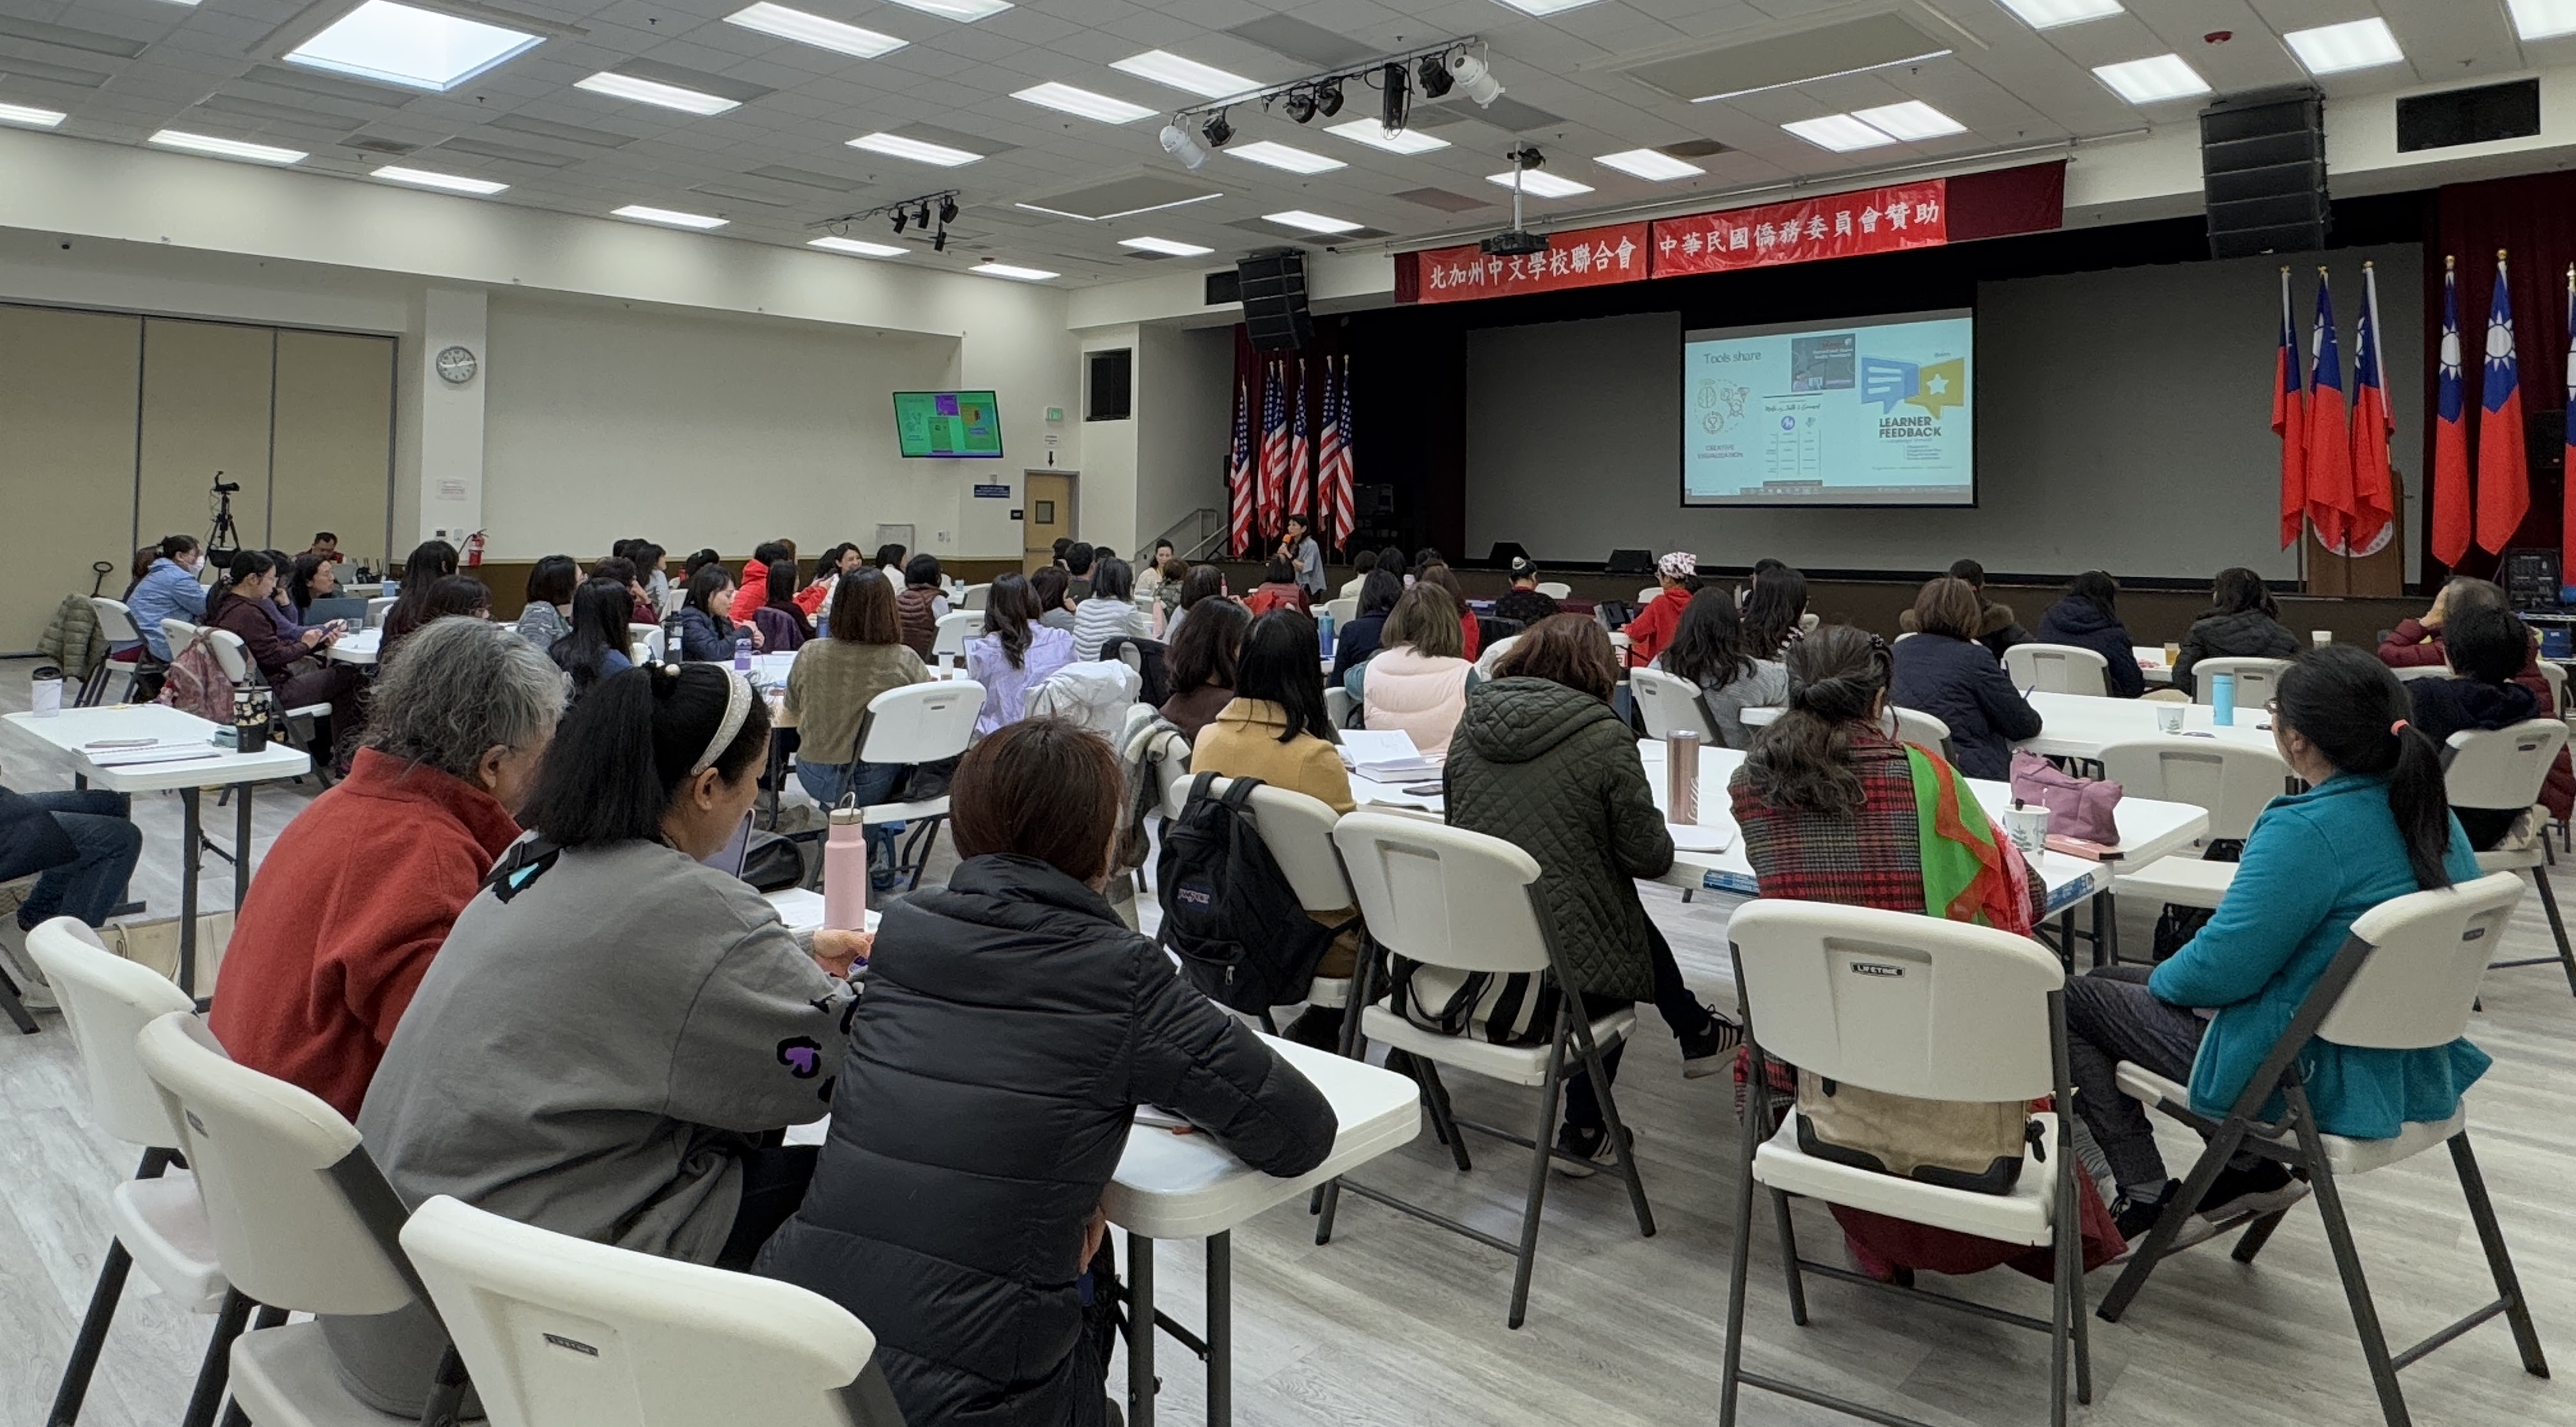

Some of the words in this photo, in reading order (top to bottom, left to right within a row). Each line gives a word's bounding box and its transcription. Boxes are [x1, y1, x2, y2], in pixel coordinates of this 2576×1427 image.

[1430, 235, 1636, 289] 北加州中文學校聯合會
[1703, 352, 1731, 364] Tools
[1733, 350, 1761, 362] share
[1879, 416, 1932, 427] LEARNER
[1879, 426, 1942, 438] FEEDBACK
